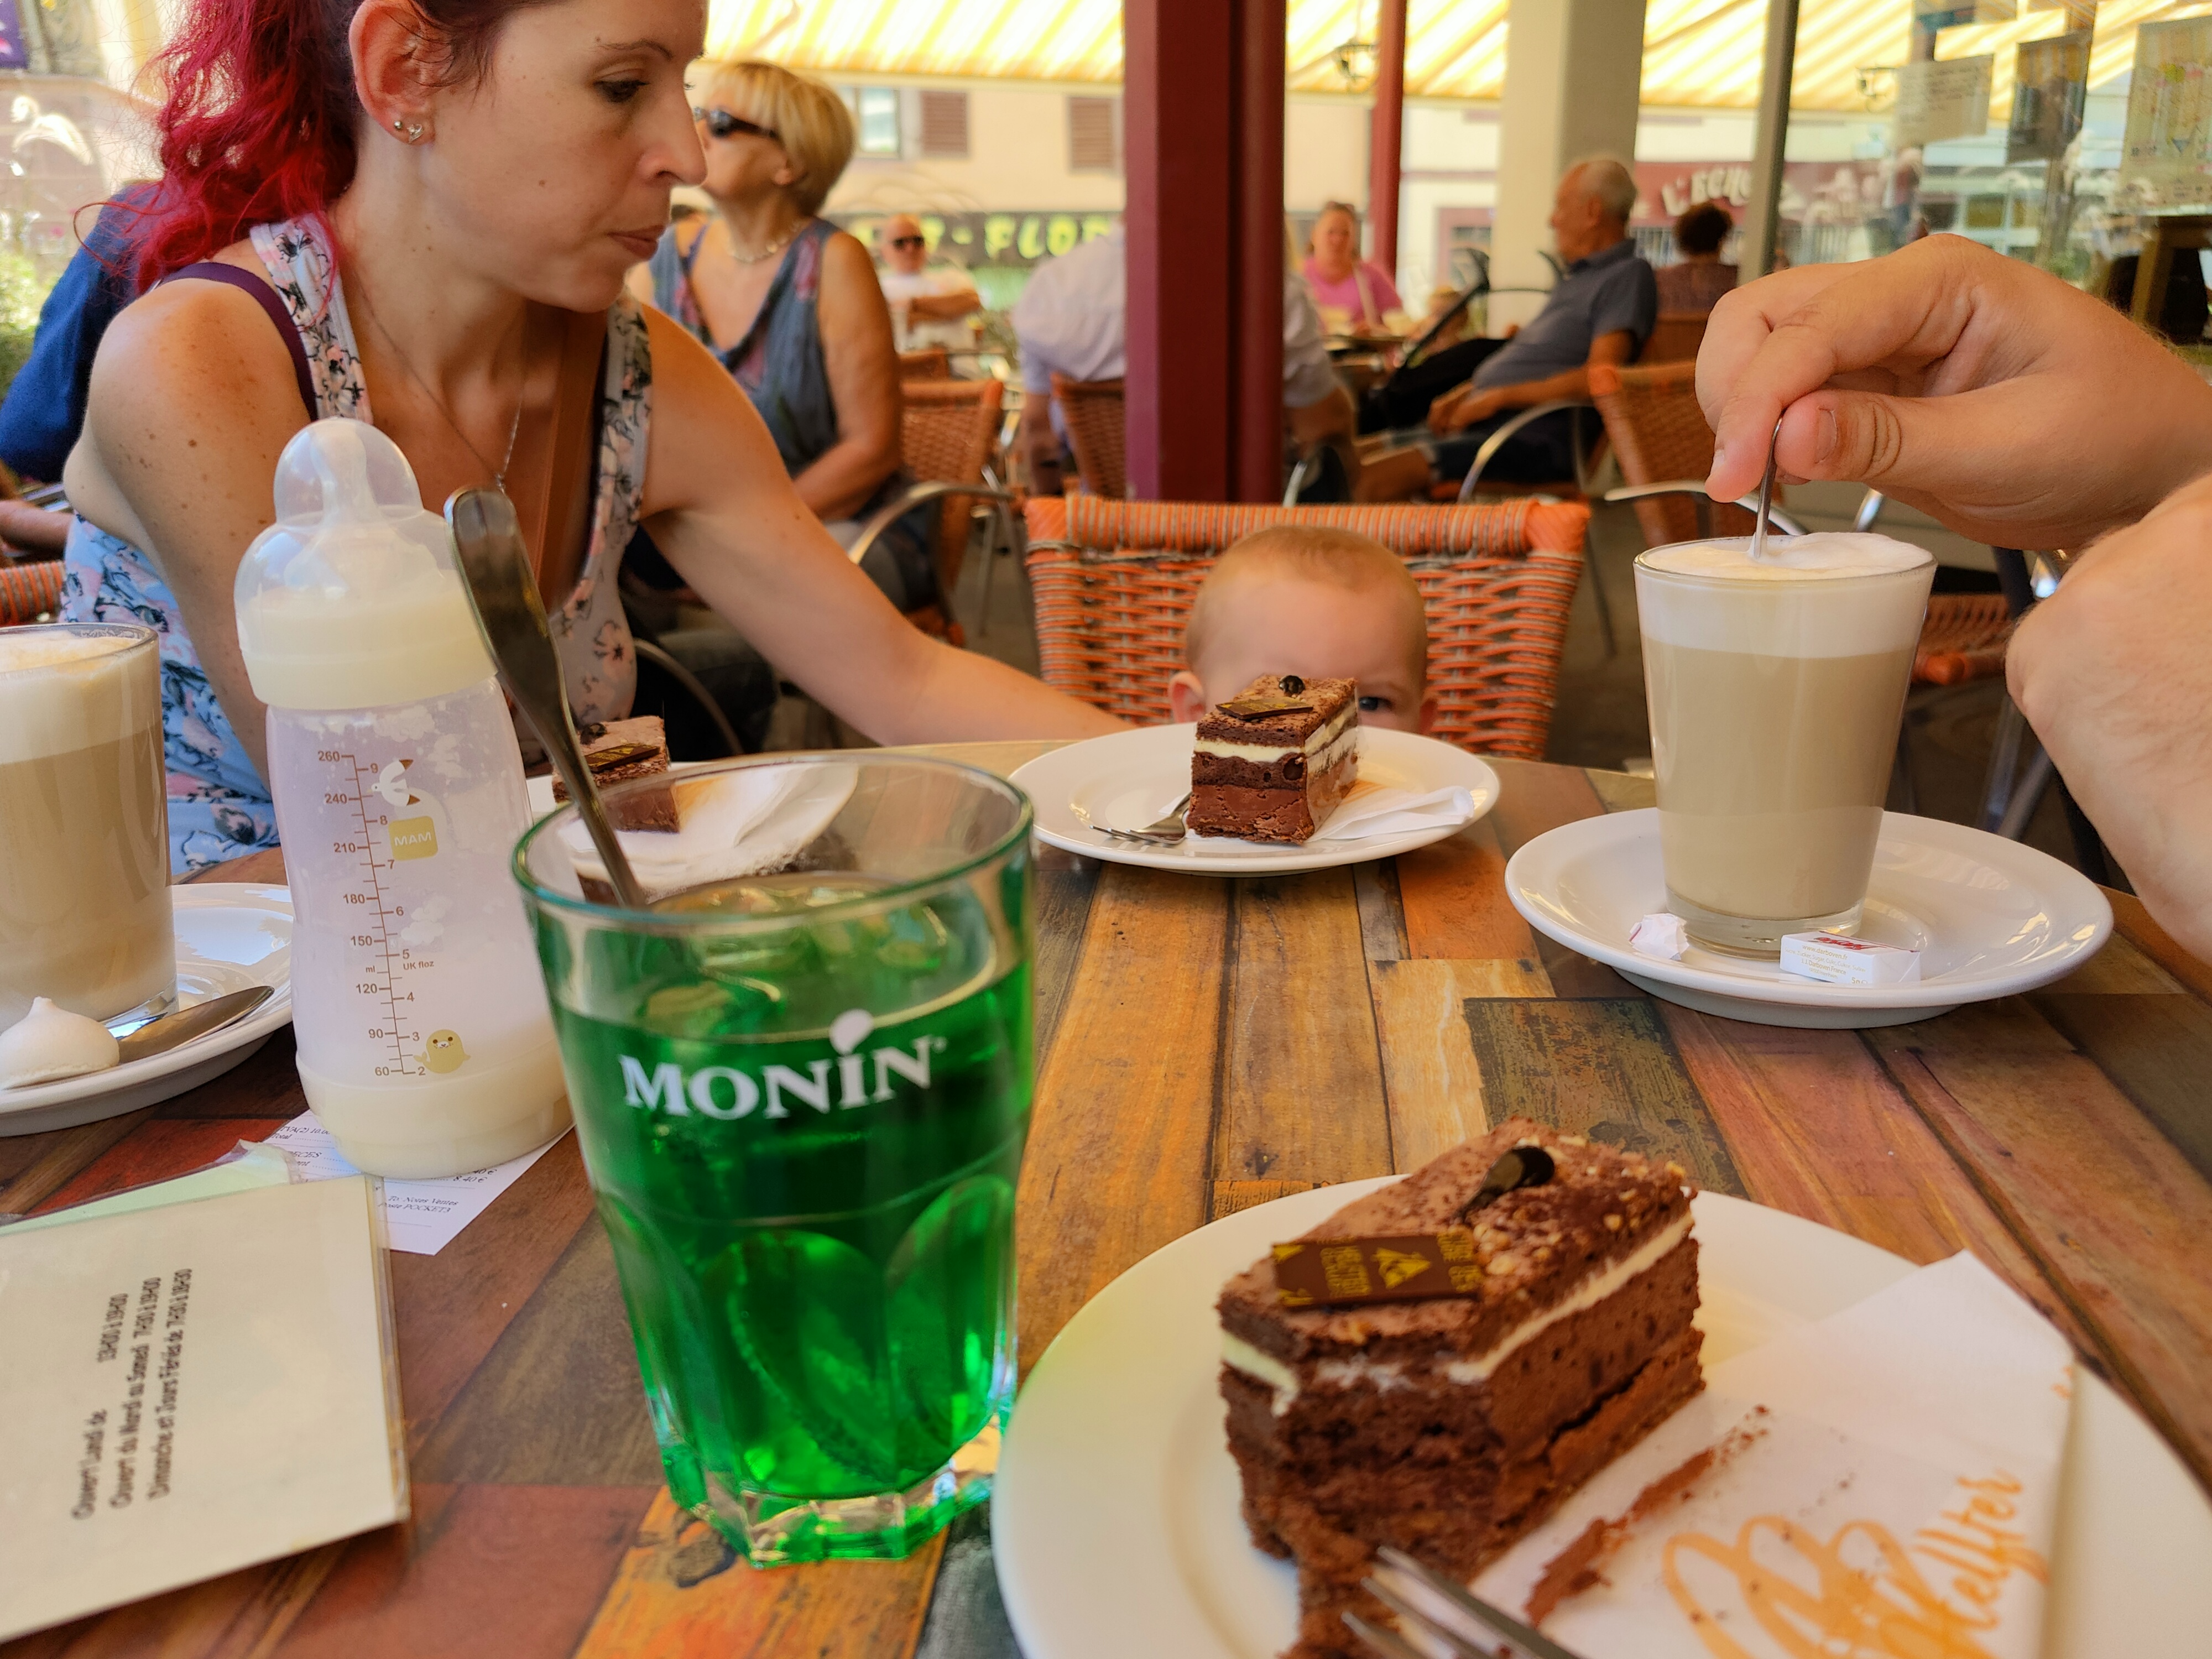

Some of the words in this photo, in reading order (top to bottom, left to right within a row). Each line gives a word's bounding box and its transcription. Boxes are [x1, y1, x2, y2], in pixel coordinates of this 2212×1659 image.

[317, 750, 341, 762] 260
[370, 763, 378, 774] 9
[325, 793, 347, 804] 240
[380, 815, 388, 825] 8
[394, 831, 432, 846] MAM
[333, 842, 356, 853] 210
[387, 859, 395, 869] 7
[343, 894, 366, 904] 180
[395, 906, 404, 916] 6
[351, 936, 373, 946] 150
[402, 948, 410, 959] 5
[1802, 945, 1848, 960] www.darboven.fr
[403, 962, 416, 971] UK
[1809, 960, 1830, 971] Darboven
[1831, 966, 1846, 975] France
[356, 983, 378, 994] 120
[406, 992, 415, 1002] 4
[368, 1028, 384, 1039] 90
[412, 1031, 420, 1041] 3
[618, 1010, 937, 1120] MONIN
[374, 1066, 390, 1076] 60
[418, 1066, 426, 1076] 2
